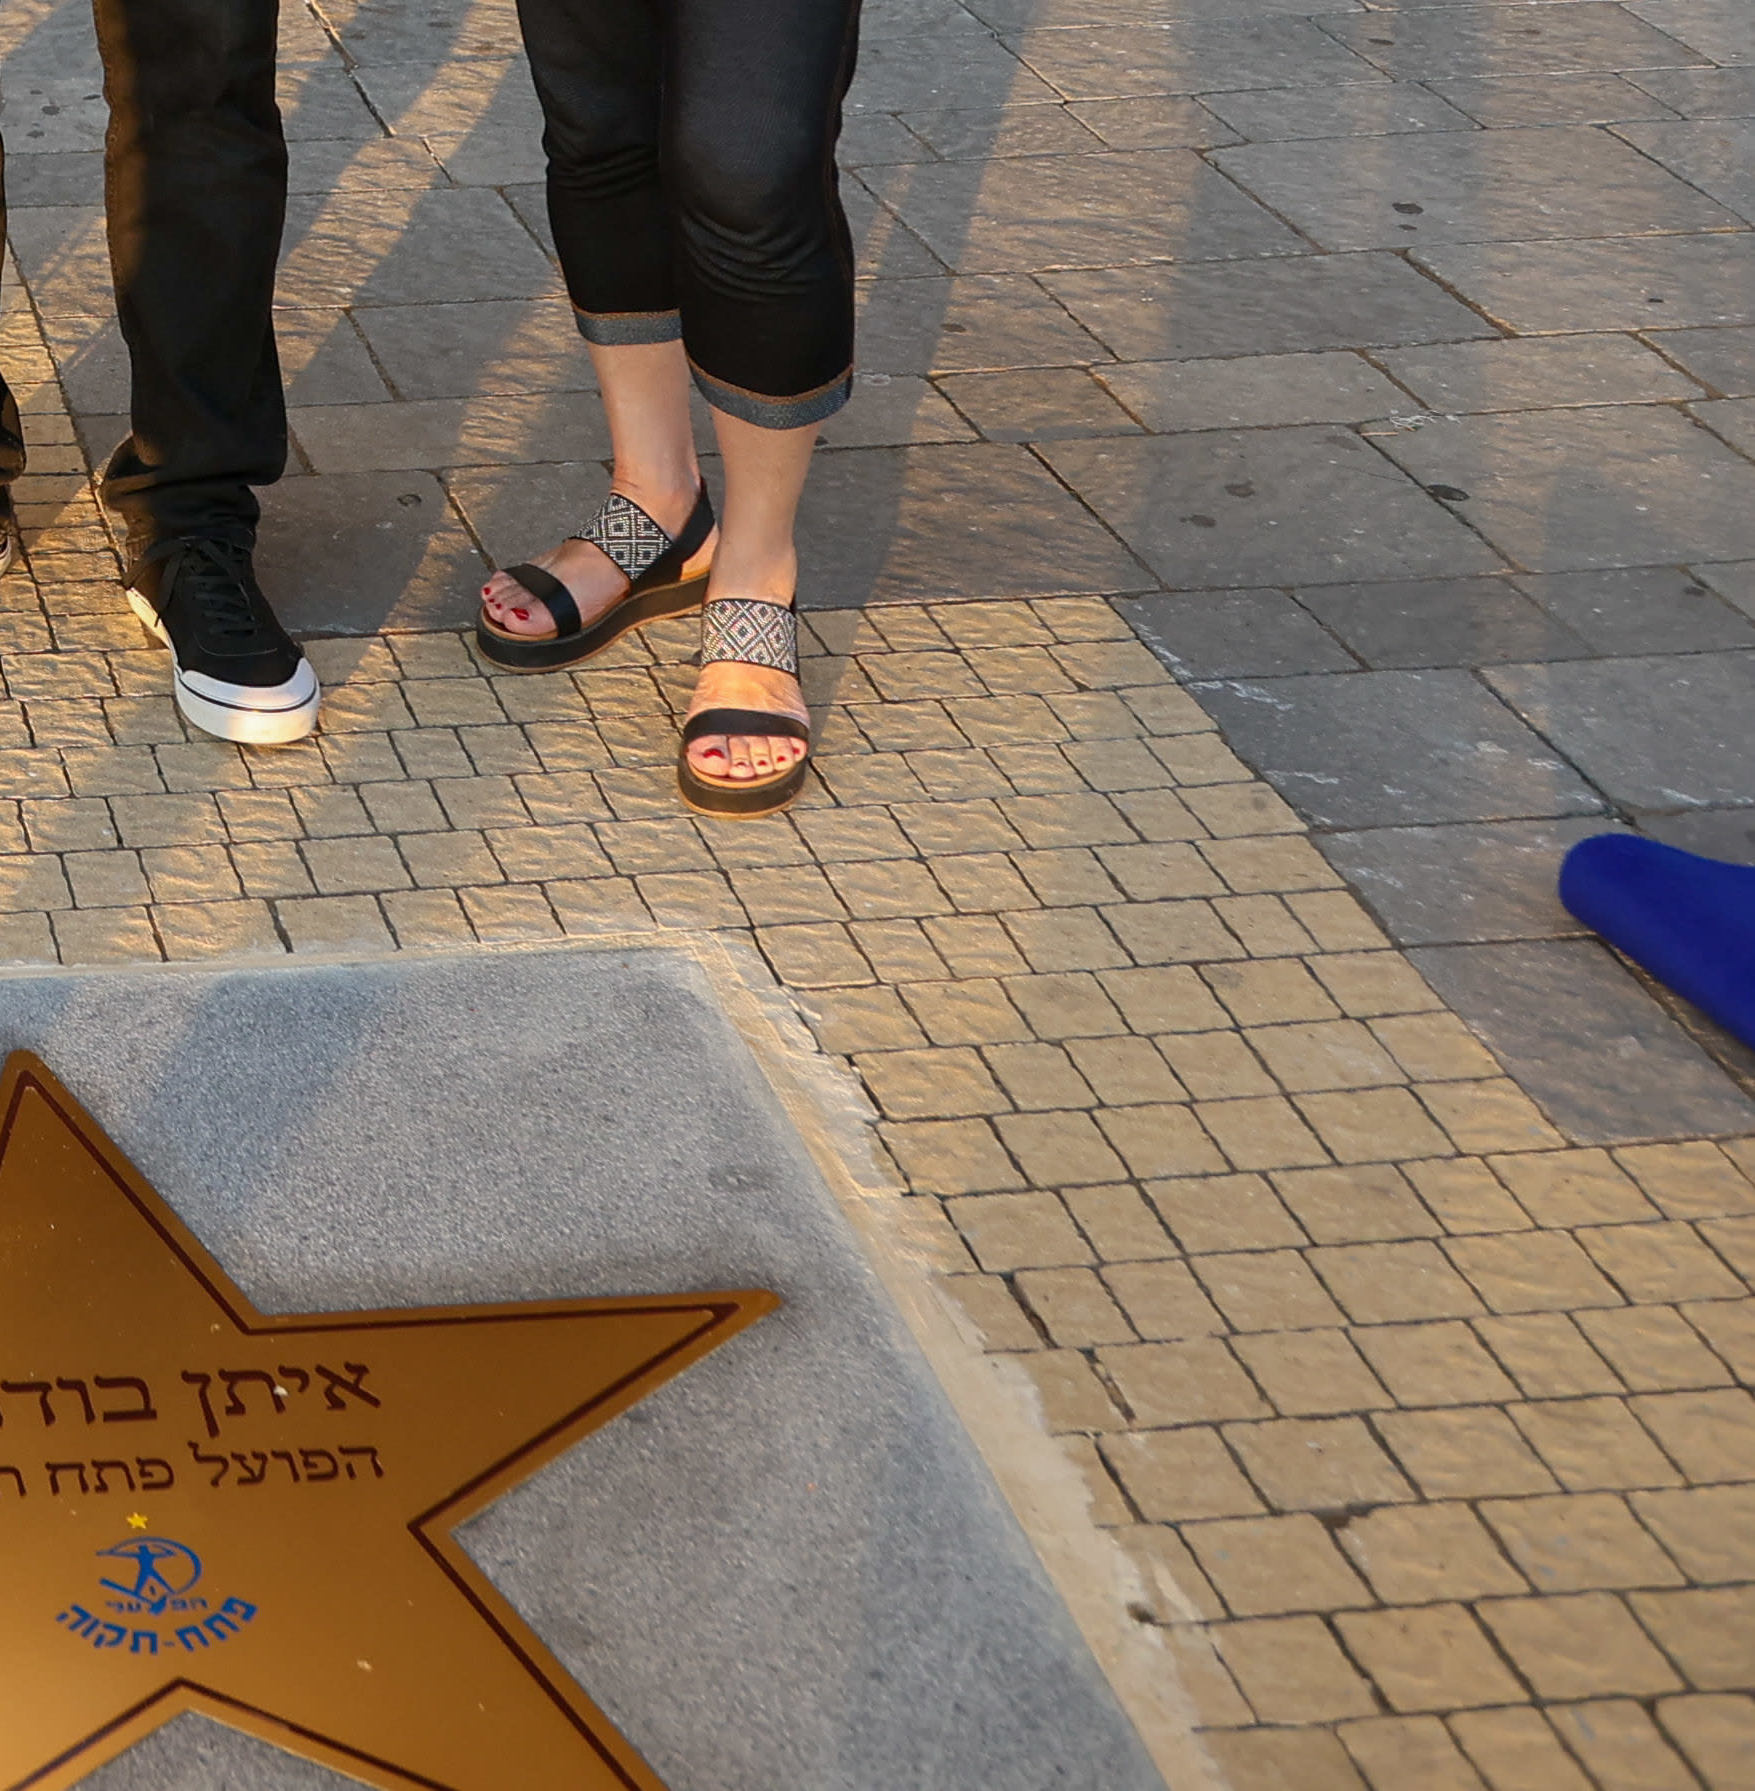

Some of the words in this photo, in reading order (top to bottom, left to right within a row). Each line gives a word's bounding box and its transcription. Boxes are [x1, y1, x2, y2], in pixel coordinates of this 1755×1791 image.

[181, 1360, 382, 1438] איתן
[45, 1456, 175, 1496] פתח
[187, 1440, 384, 1488] הפועל
